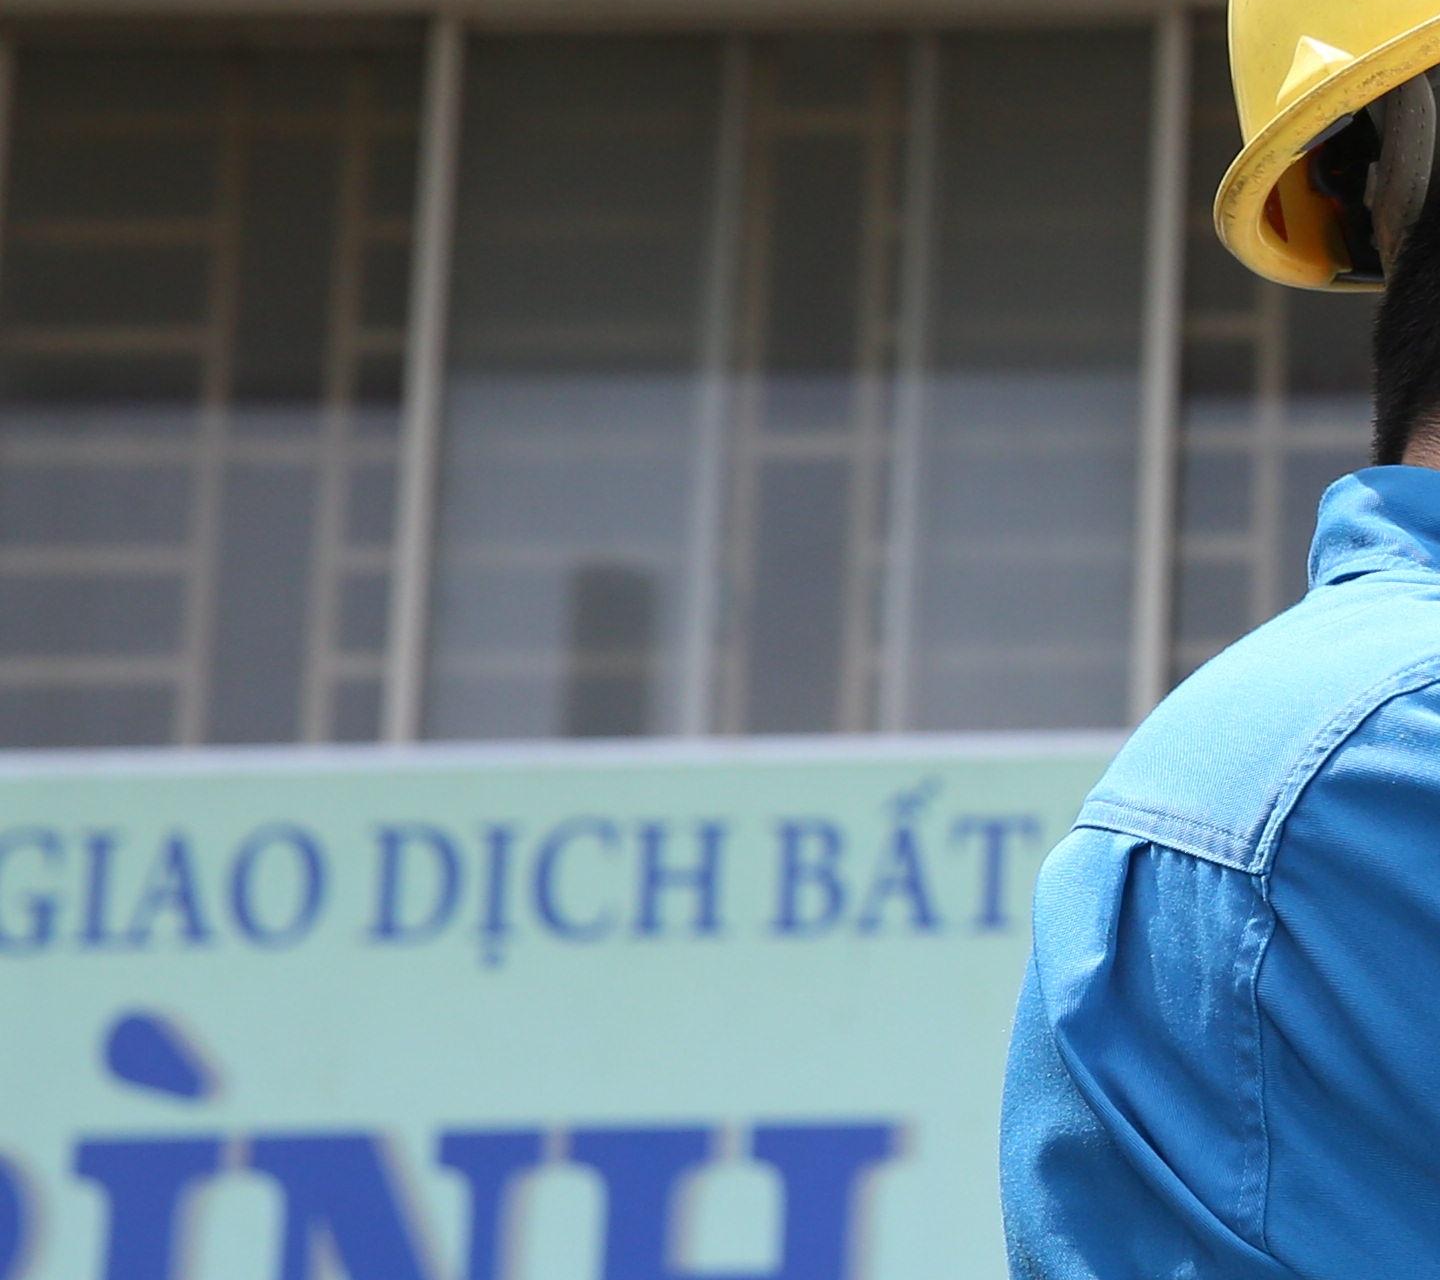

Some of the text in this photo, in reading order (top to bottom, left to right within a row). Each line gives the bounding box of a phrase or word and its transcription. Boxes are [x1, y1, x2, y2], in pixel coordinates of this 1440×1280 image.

[0, 776, 1040, 970] GIAO DỊCH BẤT
